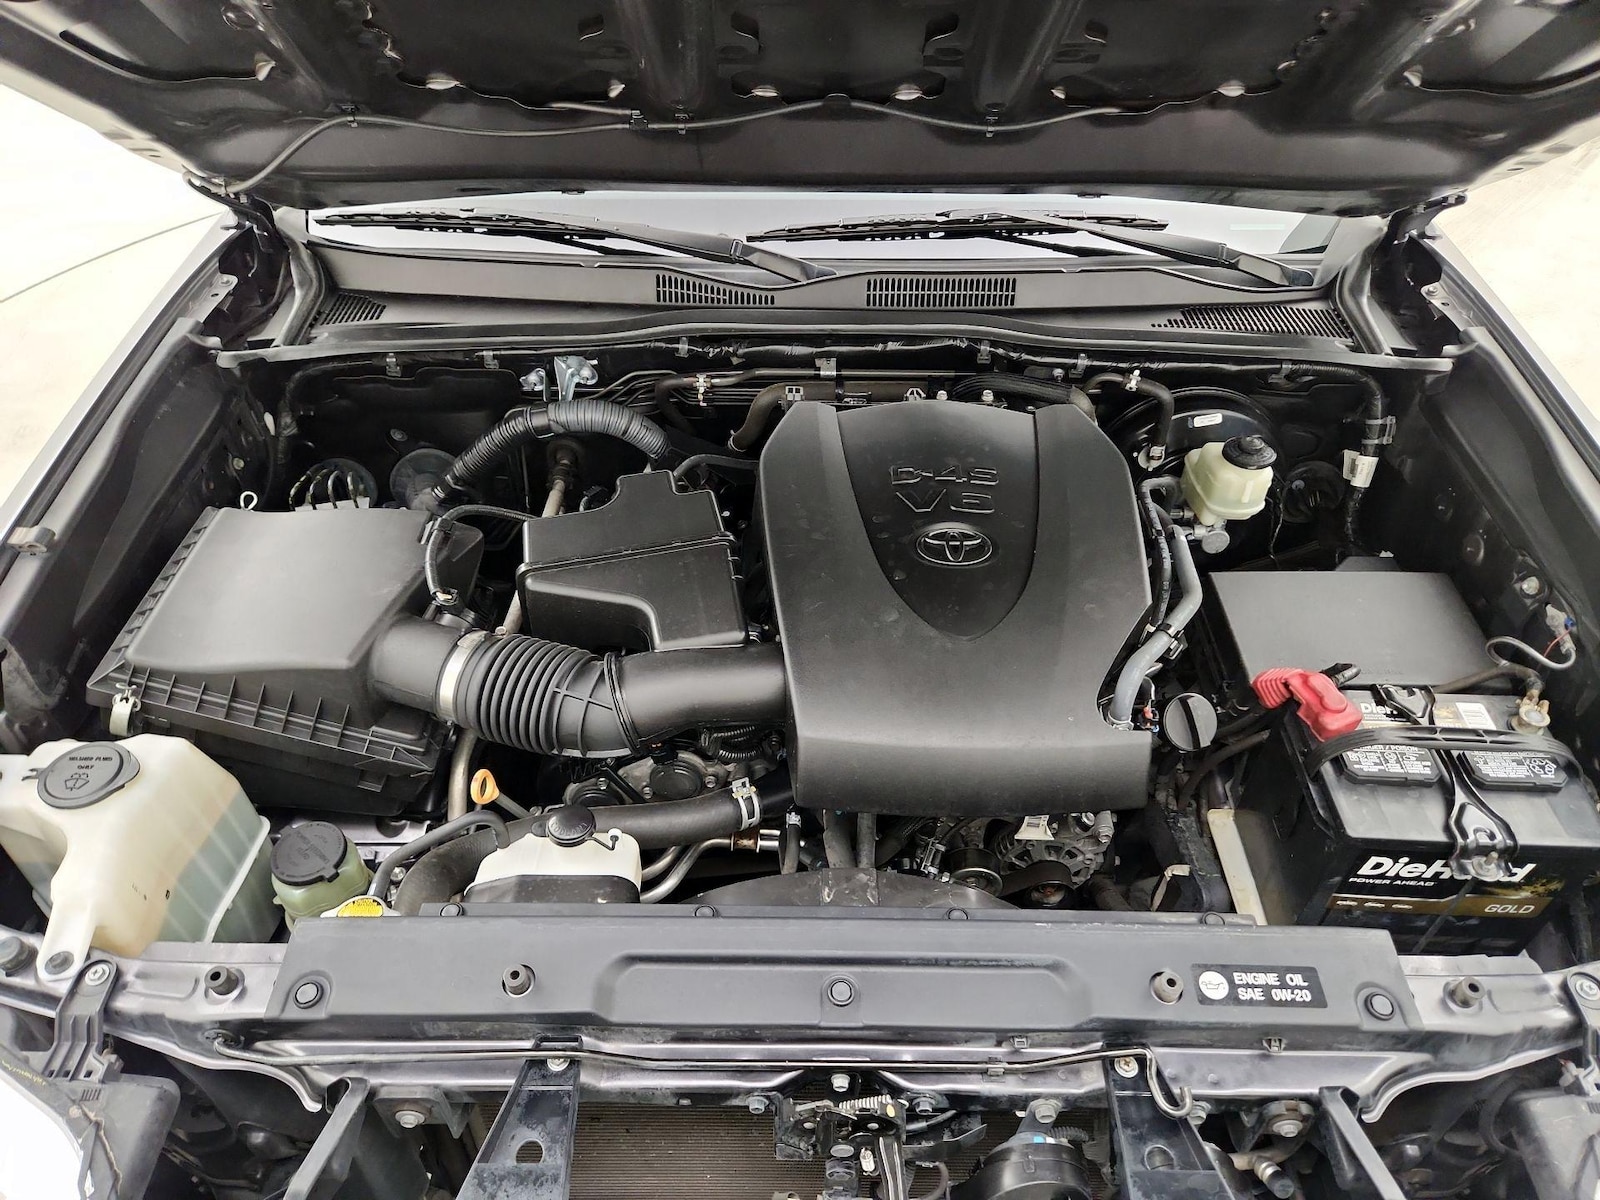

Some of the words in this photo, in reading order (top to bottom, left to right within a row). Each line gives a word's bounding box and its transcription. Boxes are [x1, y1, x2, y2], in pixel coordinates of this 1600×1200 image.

[895, 488, 995, 513] V6
[1357, 856, 1536, 882] DieHd
[1484, 904, 1535, 914] GOLD
[1233, 972, 1281, 986] ENGINE
[1285, 973, 1309, 987] OIL
[1237, 987, 1266, 1001] SAE
[1271, 988, 1312, 1002] 0W-20
